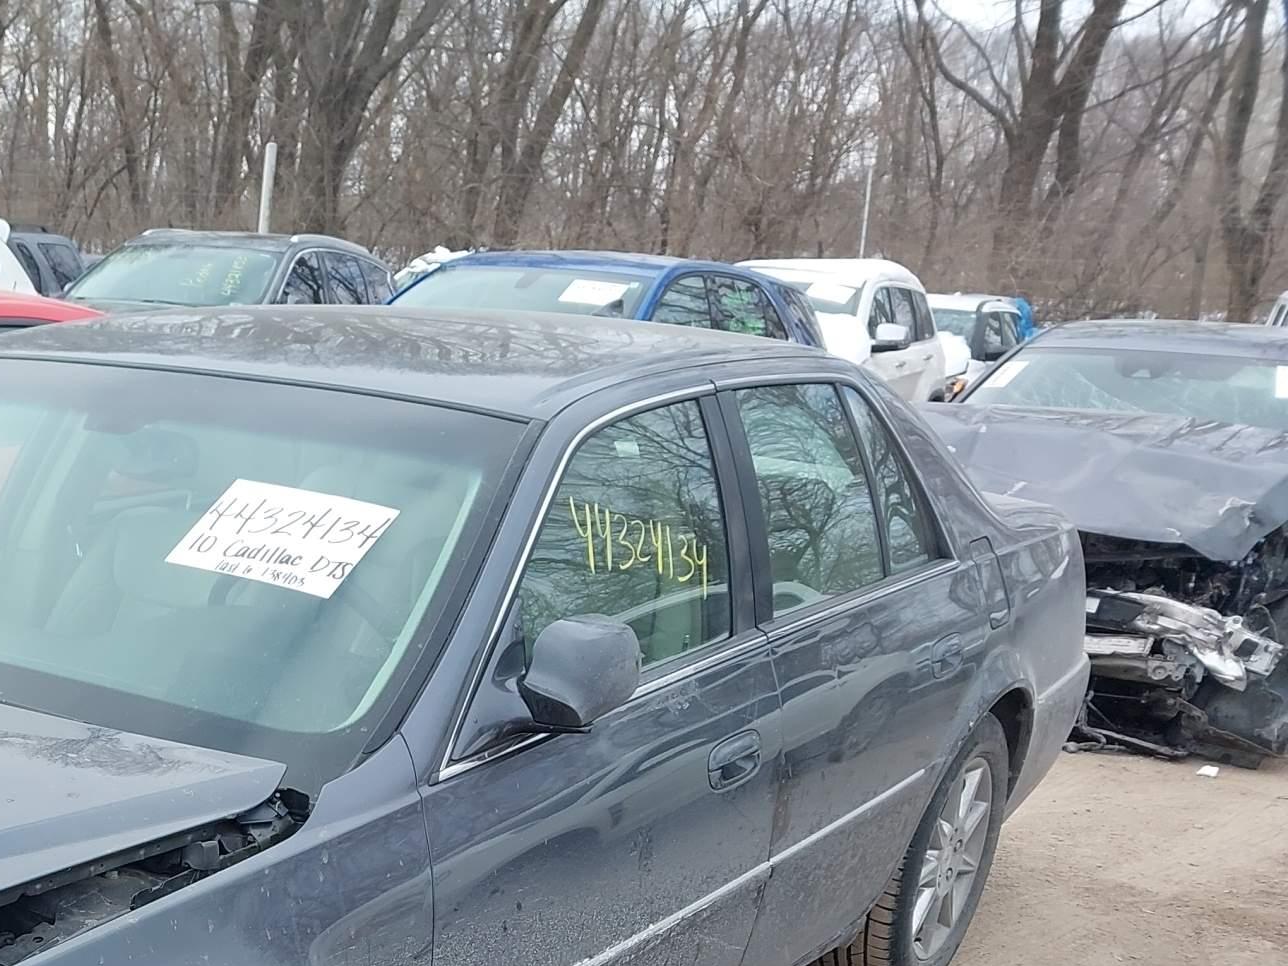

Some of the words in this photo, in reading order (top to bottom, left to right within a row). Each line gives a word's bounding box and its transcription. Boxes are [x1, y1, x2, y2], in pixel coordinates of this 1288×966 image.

[209, 498, 391, 548] 44324134
[569, 496, 707, 600] 44324134
[188, 533, 218, 552] 10
[223, 540, 303, 566] Cadillac
[307, 555, 354, 580] DTS
